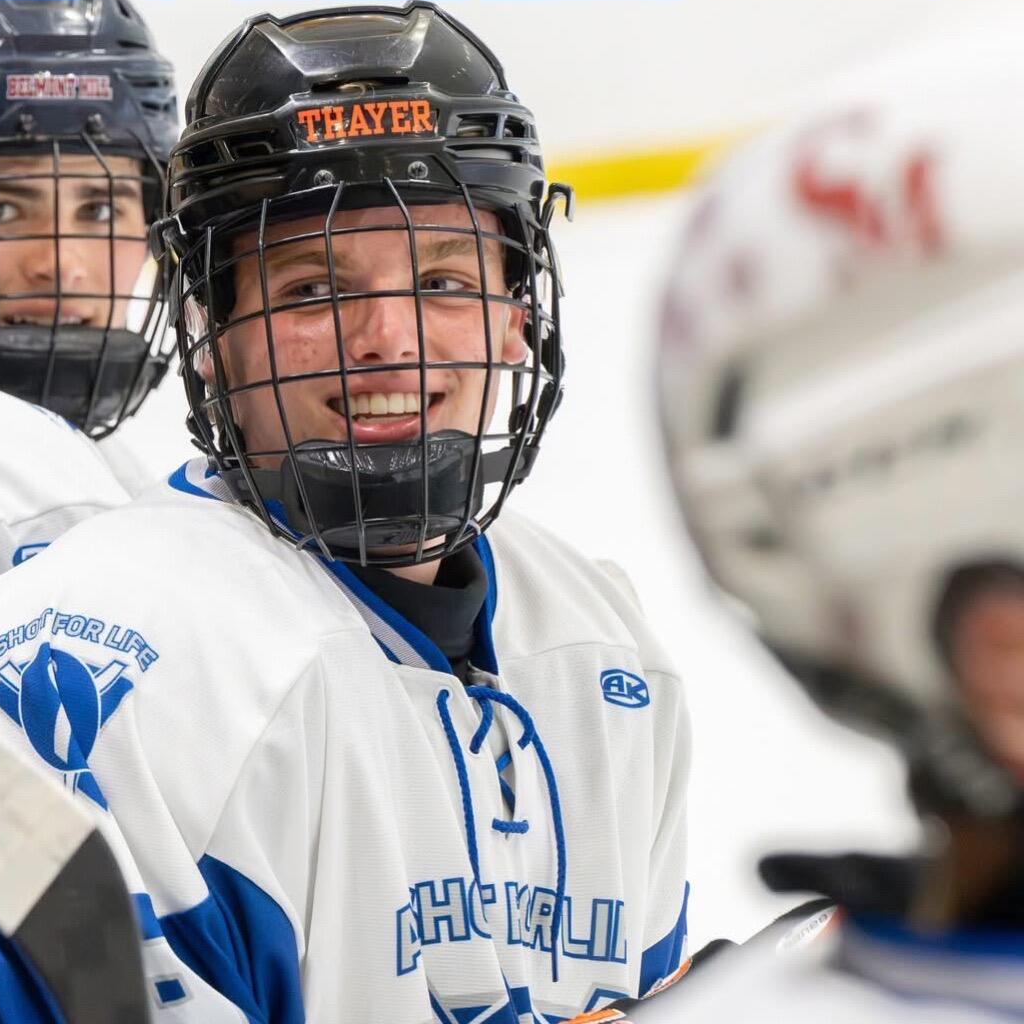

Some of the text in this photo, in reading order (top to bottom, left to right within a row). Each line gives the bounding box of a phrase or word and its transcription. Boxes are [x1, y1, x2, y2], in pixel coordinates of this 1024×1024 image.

[297, 99, 434, 143] THAYER
[51, 612, 106, 643] FOR
[104, 624, 160, 673] LIFE
[601, 671, 650, 707] AK
